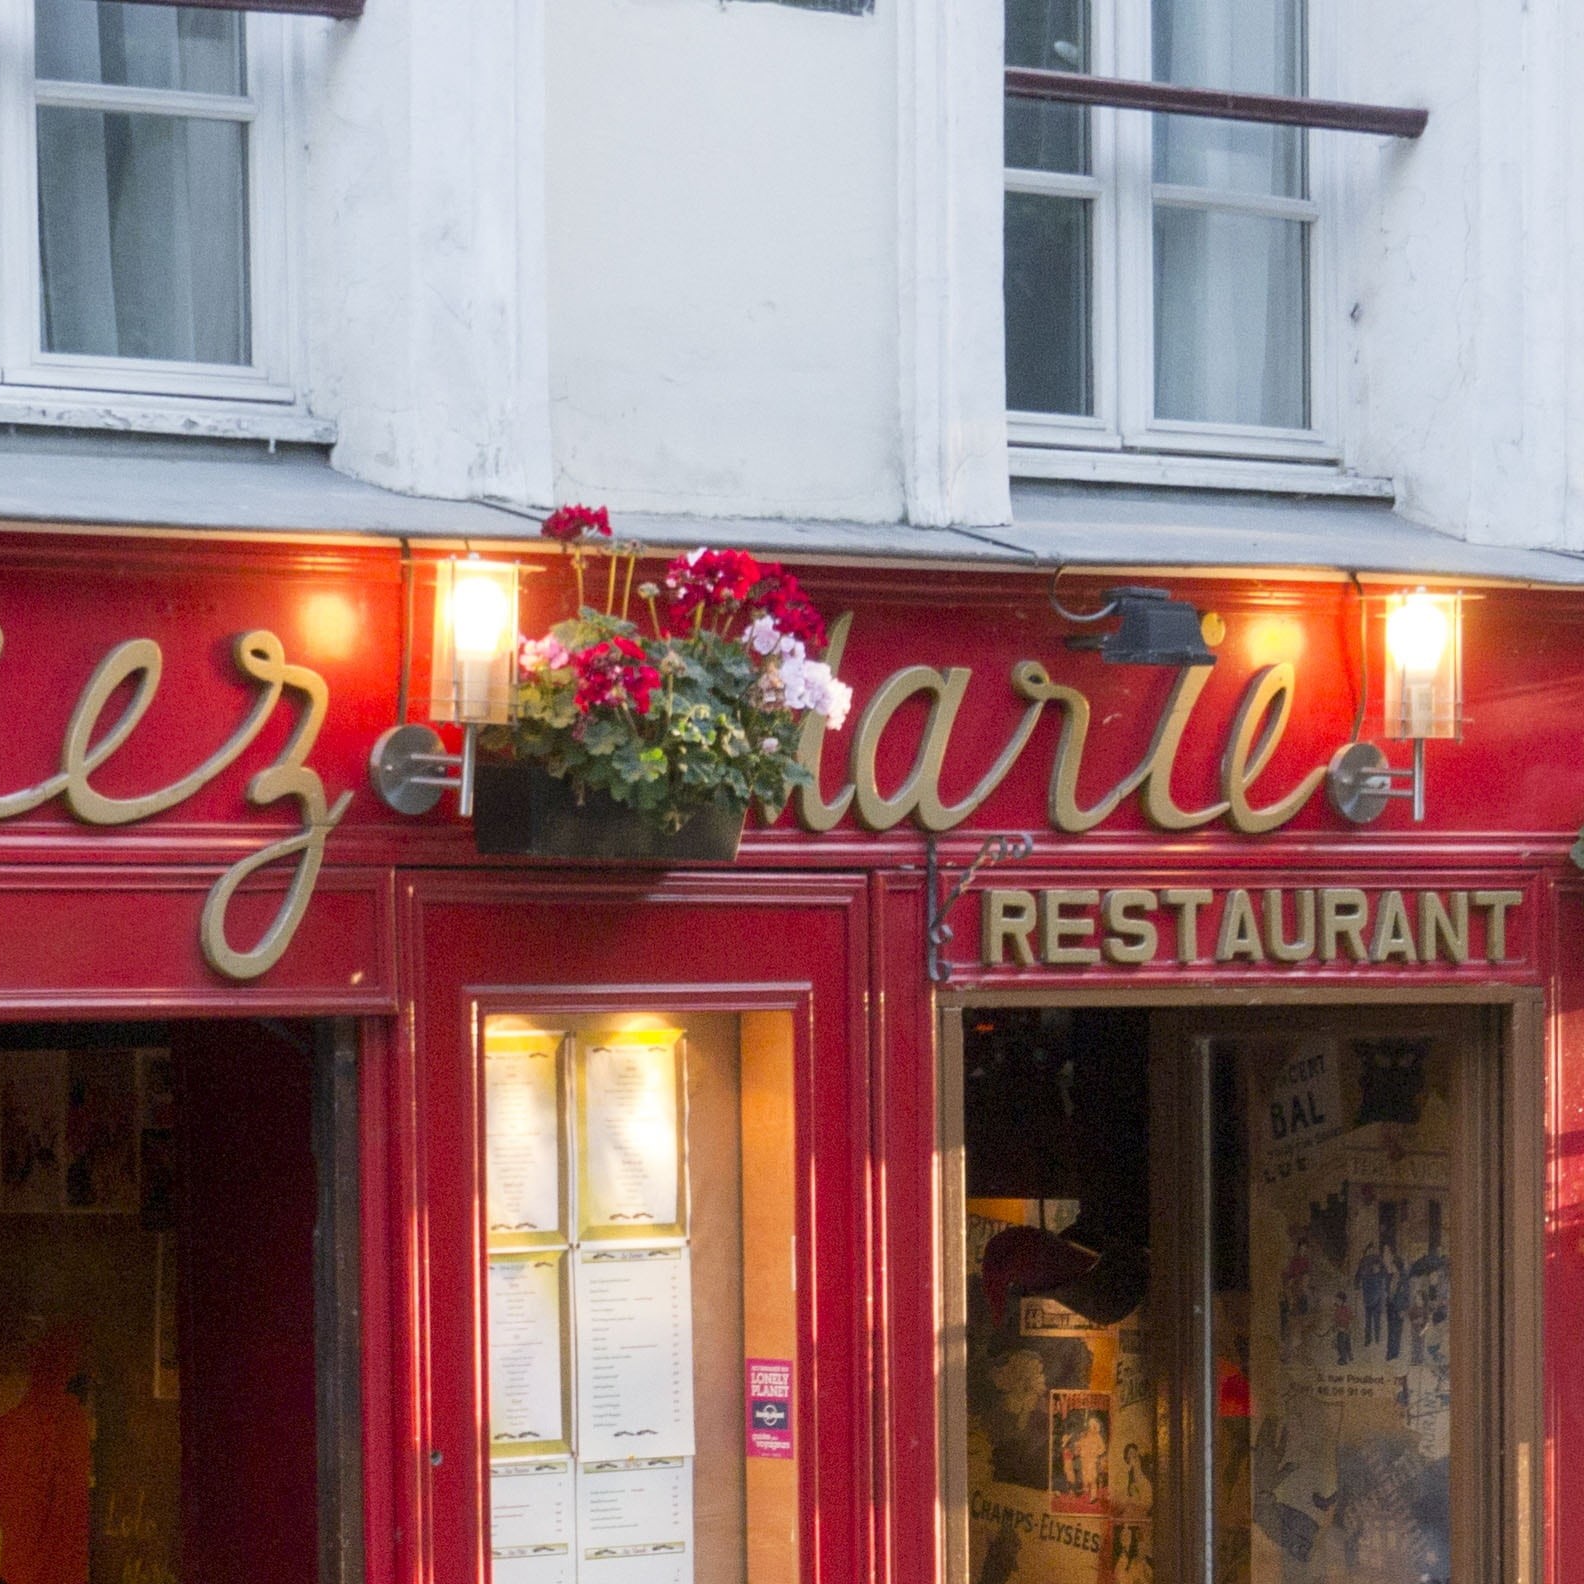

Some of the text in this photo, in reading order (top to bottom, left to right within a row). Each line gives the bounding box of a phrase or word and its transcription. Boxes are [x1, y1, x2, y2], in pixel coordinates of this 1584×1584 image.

[982, 887, 1523, 965] RESTAURANT
[1270, 1090, 1325, 1140] BAL
[751, 1372, 789, 1385] LONELY
[751, 1385, 789, 1398] PLANET
